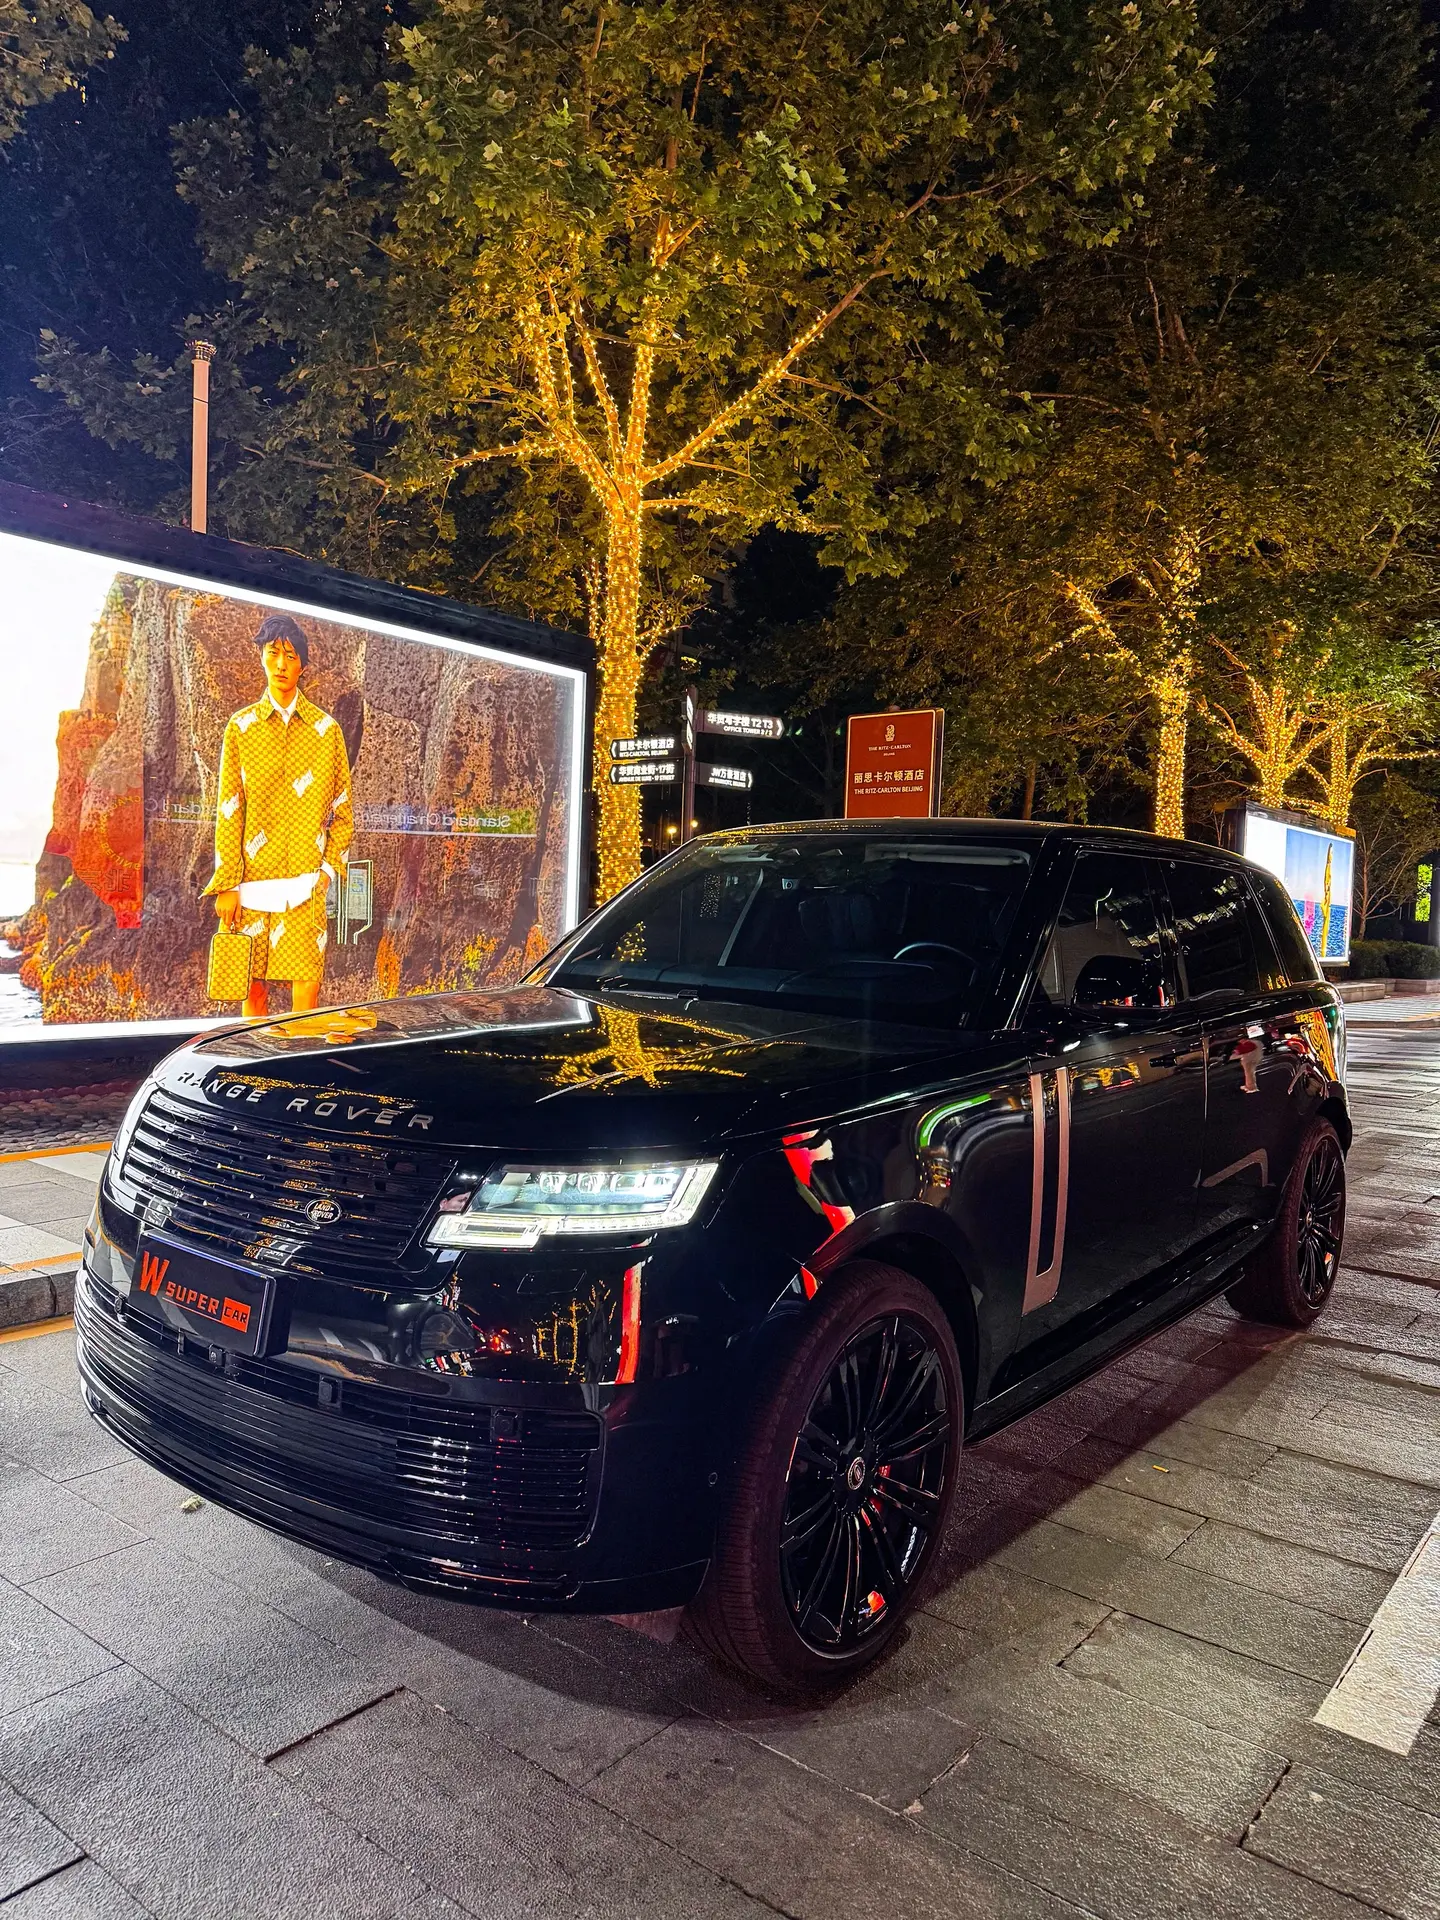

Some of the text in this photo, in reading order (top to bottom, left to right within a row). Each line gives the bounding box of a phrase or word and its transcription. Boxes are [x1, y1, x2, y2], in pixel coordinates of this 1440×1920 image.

[750, 717, 762, 728] T2
[762, 719, 773, 730] T3
[854, 769, 924, 784] 丽思卡尔顿酒店
[865, 786, 901, 794] RITZ-CARLTON
[901, 785, 923, 793] BEIJING
[177, 1070, 434, 1130] RANGE ROVER
[313, 1202, 332, 1212] LAND
[314, 1210, 334, 1219] ROVER
[139, 1250, 248, 1324] W SUPER CAR
